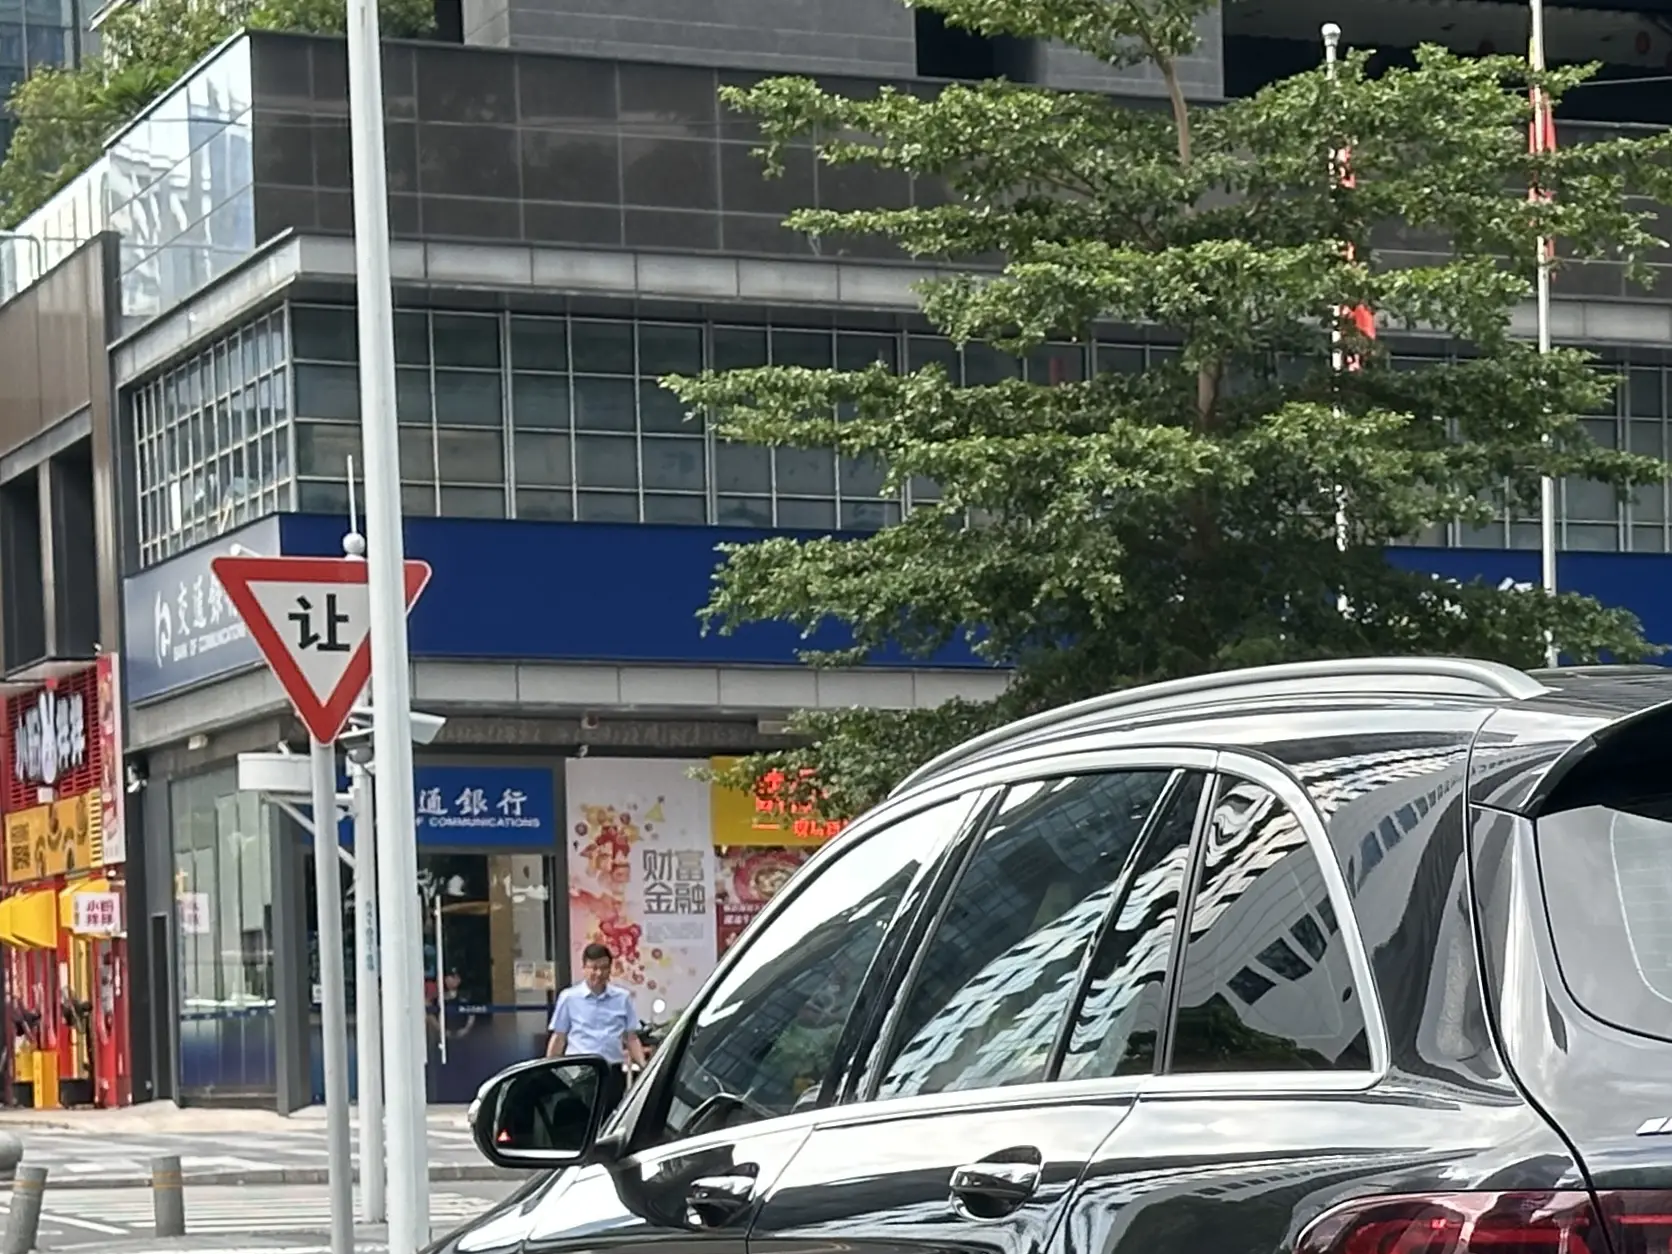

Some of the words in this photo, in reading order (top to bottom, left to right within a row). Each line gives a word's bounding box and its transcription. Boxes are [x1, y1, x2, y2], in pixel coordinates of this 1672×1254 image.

[288, 593, 351, 652] 让
[643, 849, 705, 882] 财富
[643, 883, 706, 914] 金融
